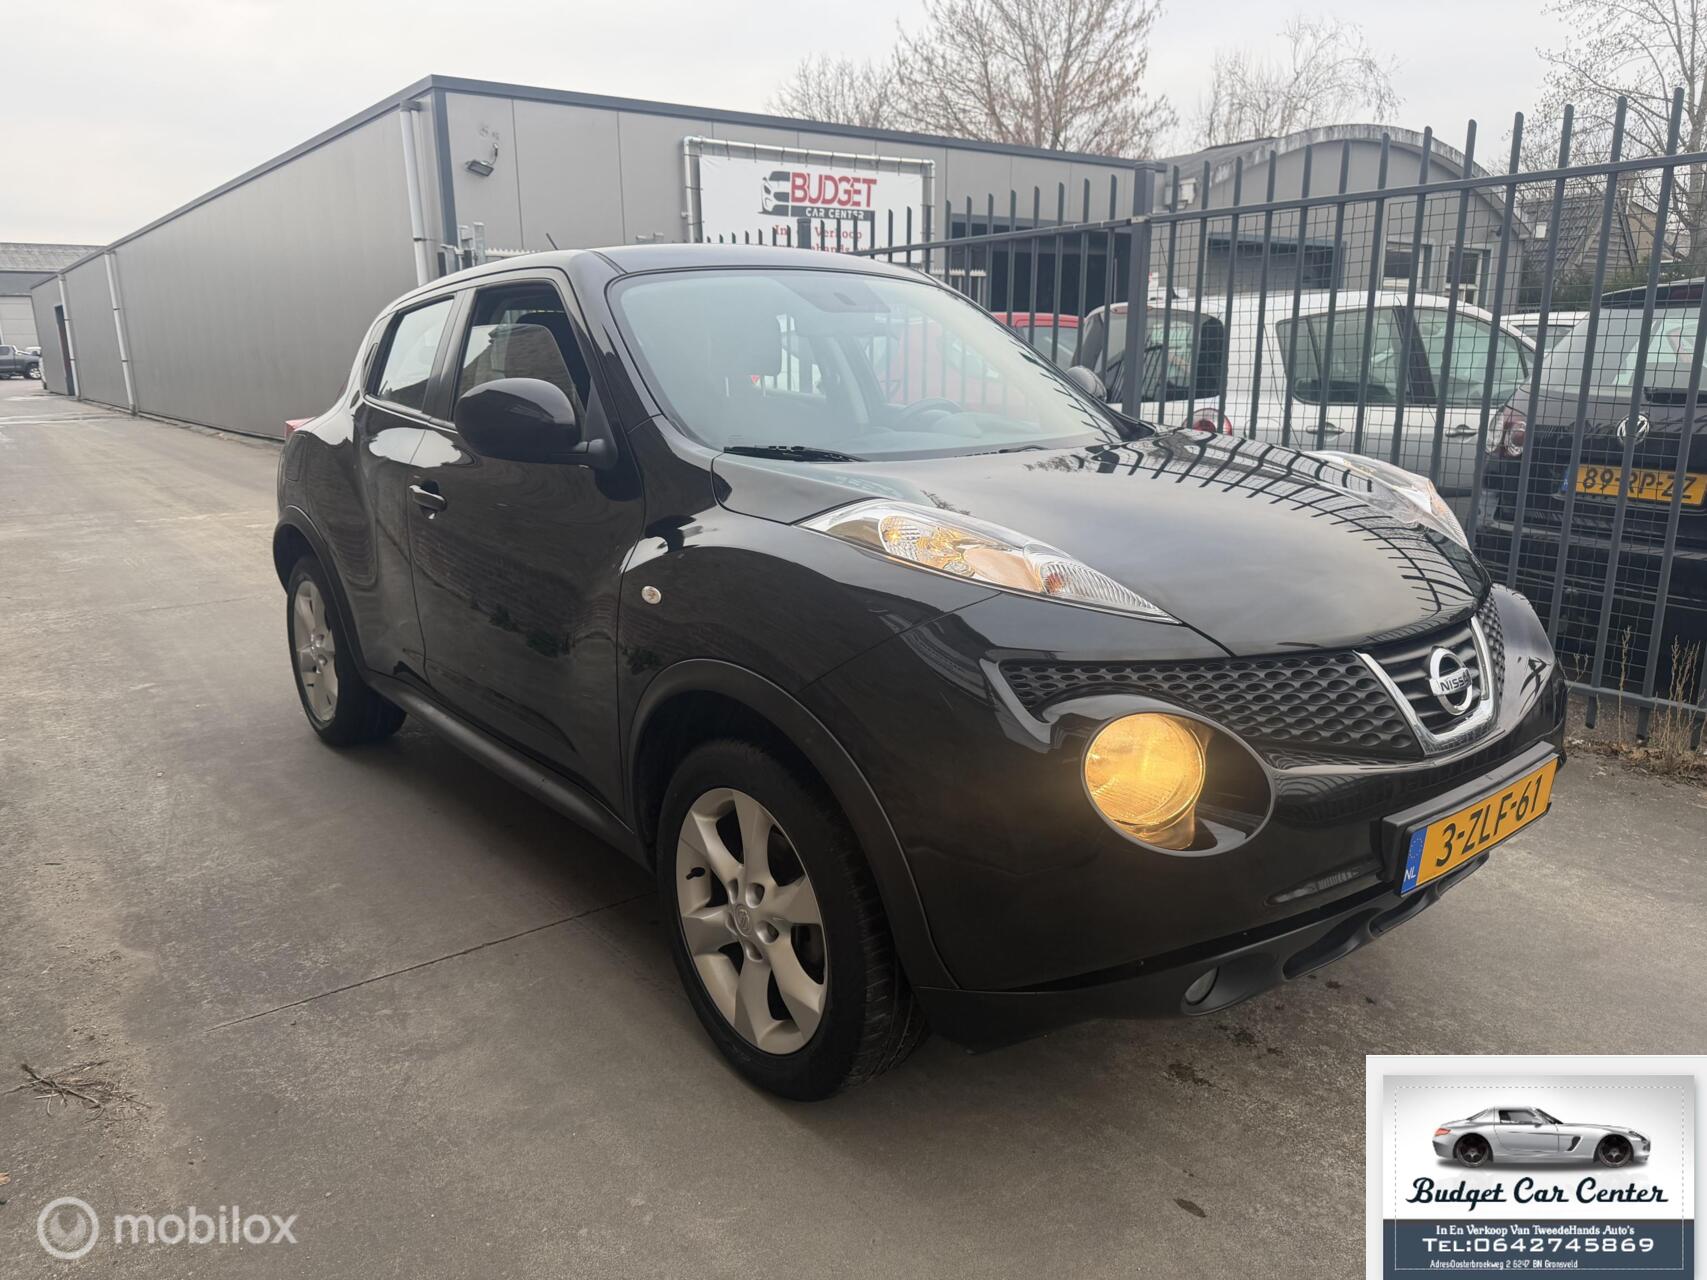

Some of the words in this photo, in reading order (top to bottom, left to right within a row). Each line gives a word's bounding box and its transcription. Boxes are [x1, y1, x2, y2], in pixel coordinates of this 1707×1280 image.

[790, 172, 878, 207] BUDGET
[805, 207, 825, 218] CAR
[1436, 774, 1544, 868] 3-ZLF-61
[1403, 866, 1417, 882] NL
